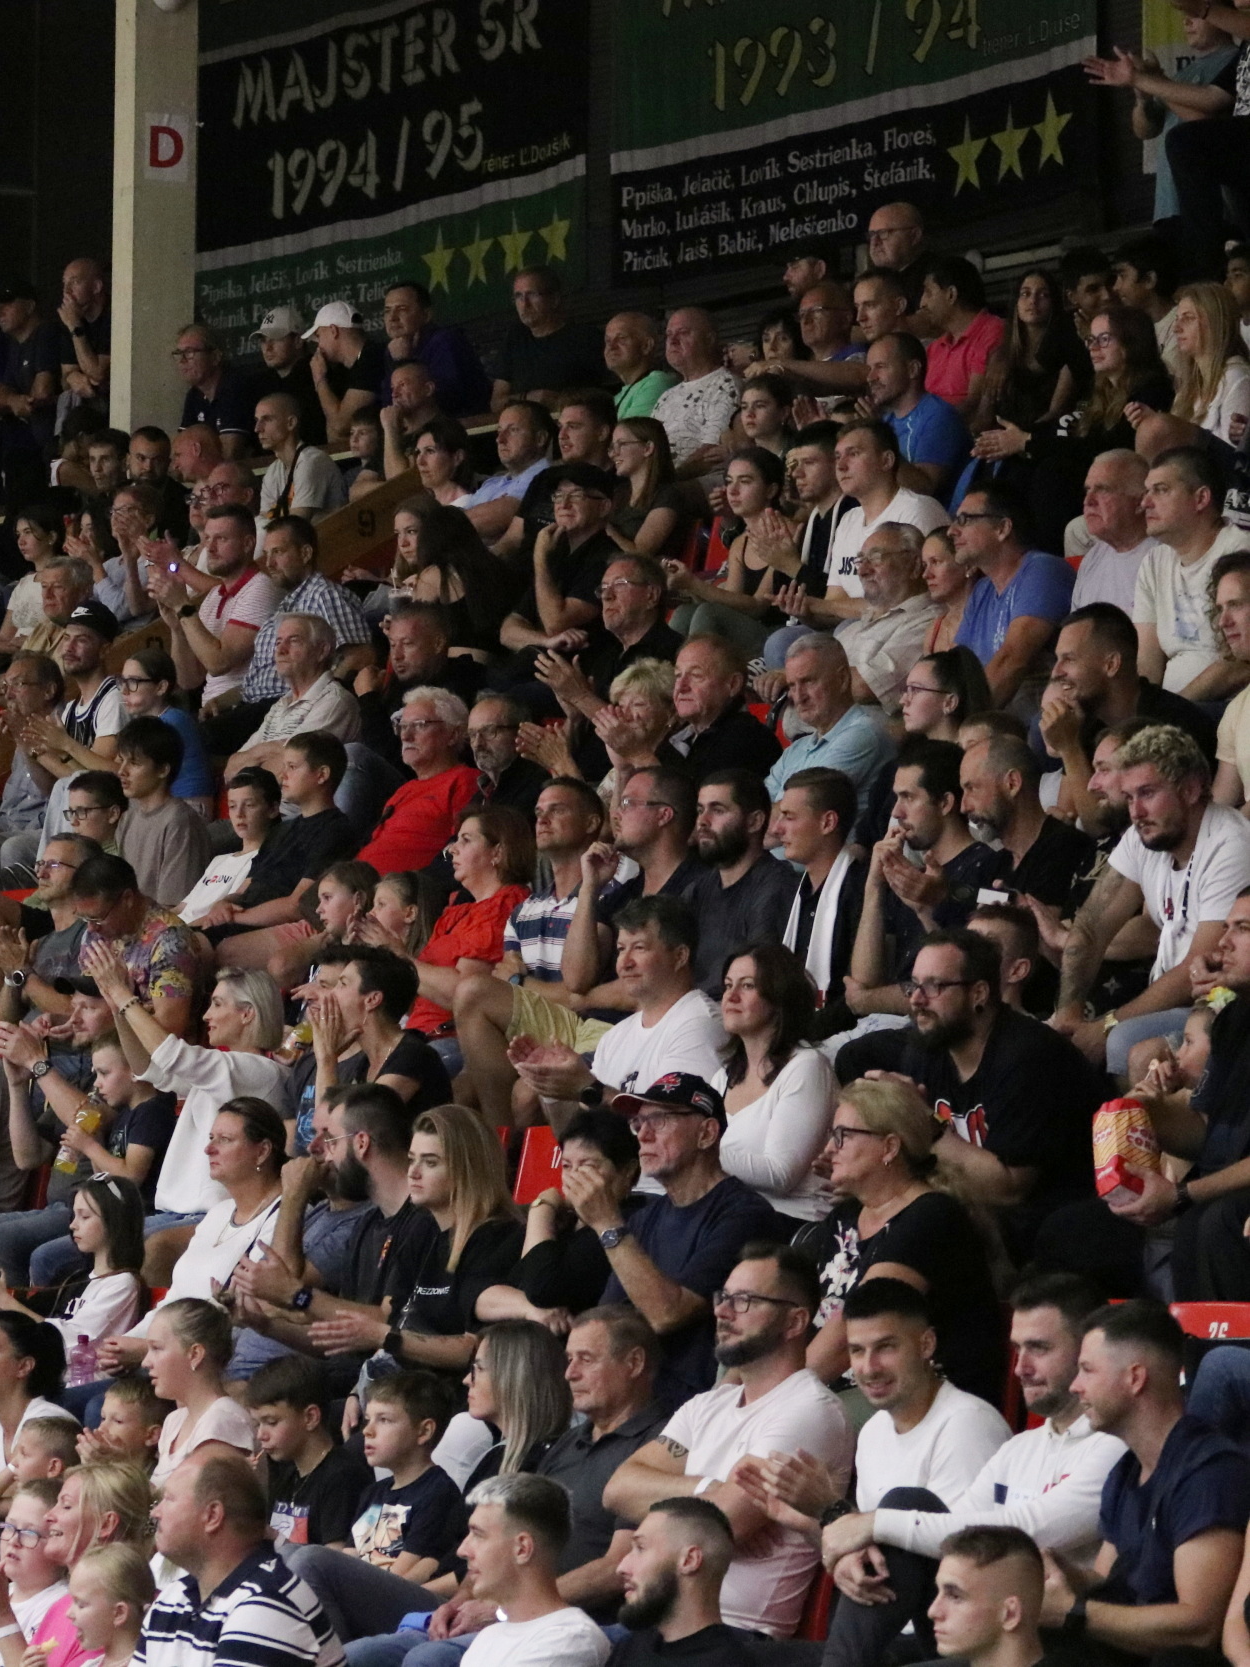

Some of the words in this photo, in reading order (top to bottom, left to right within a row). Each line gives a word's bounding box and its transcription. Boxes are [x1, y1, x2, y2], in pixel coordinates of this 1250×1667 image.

[232, 7, 461, 130] MAJSTER
[476, 0, 543, 61] SR
[706, 16, 837, 112] 1993
[149, 125, 184, 169] D
